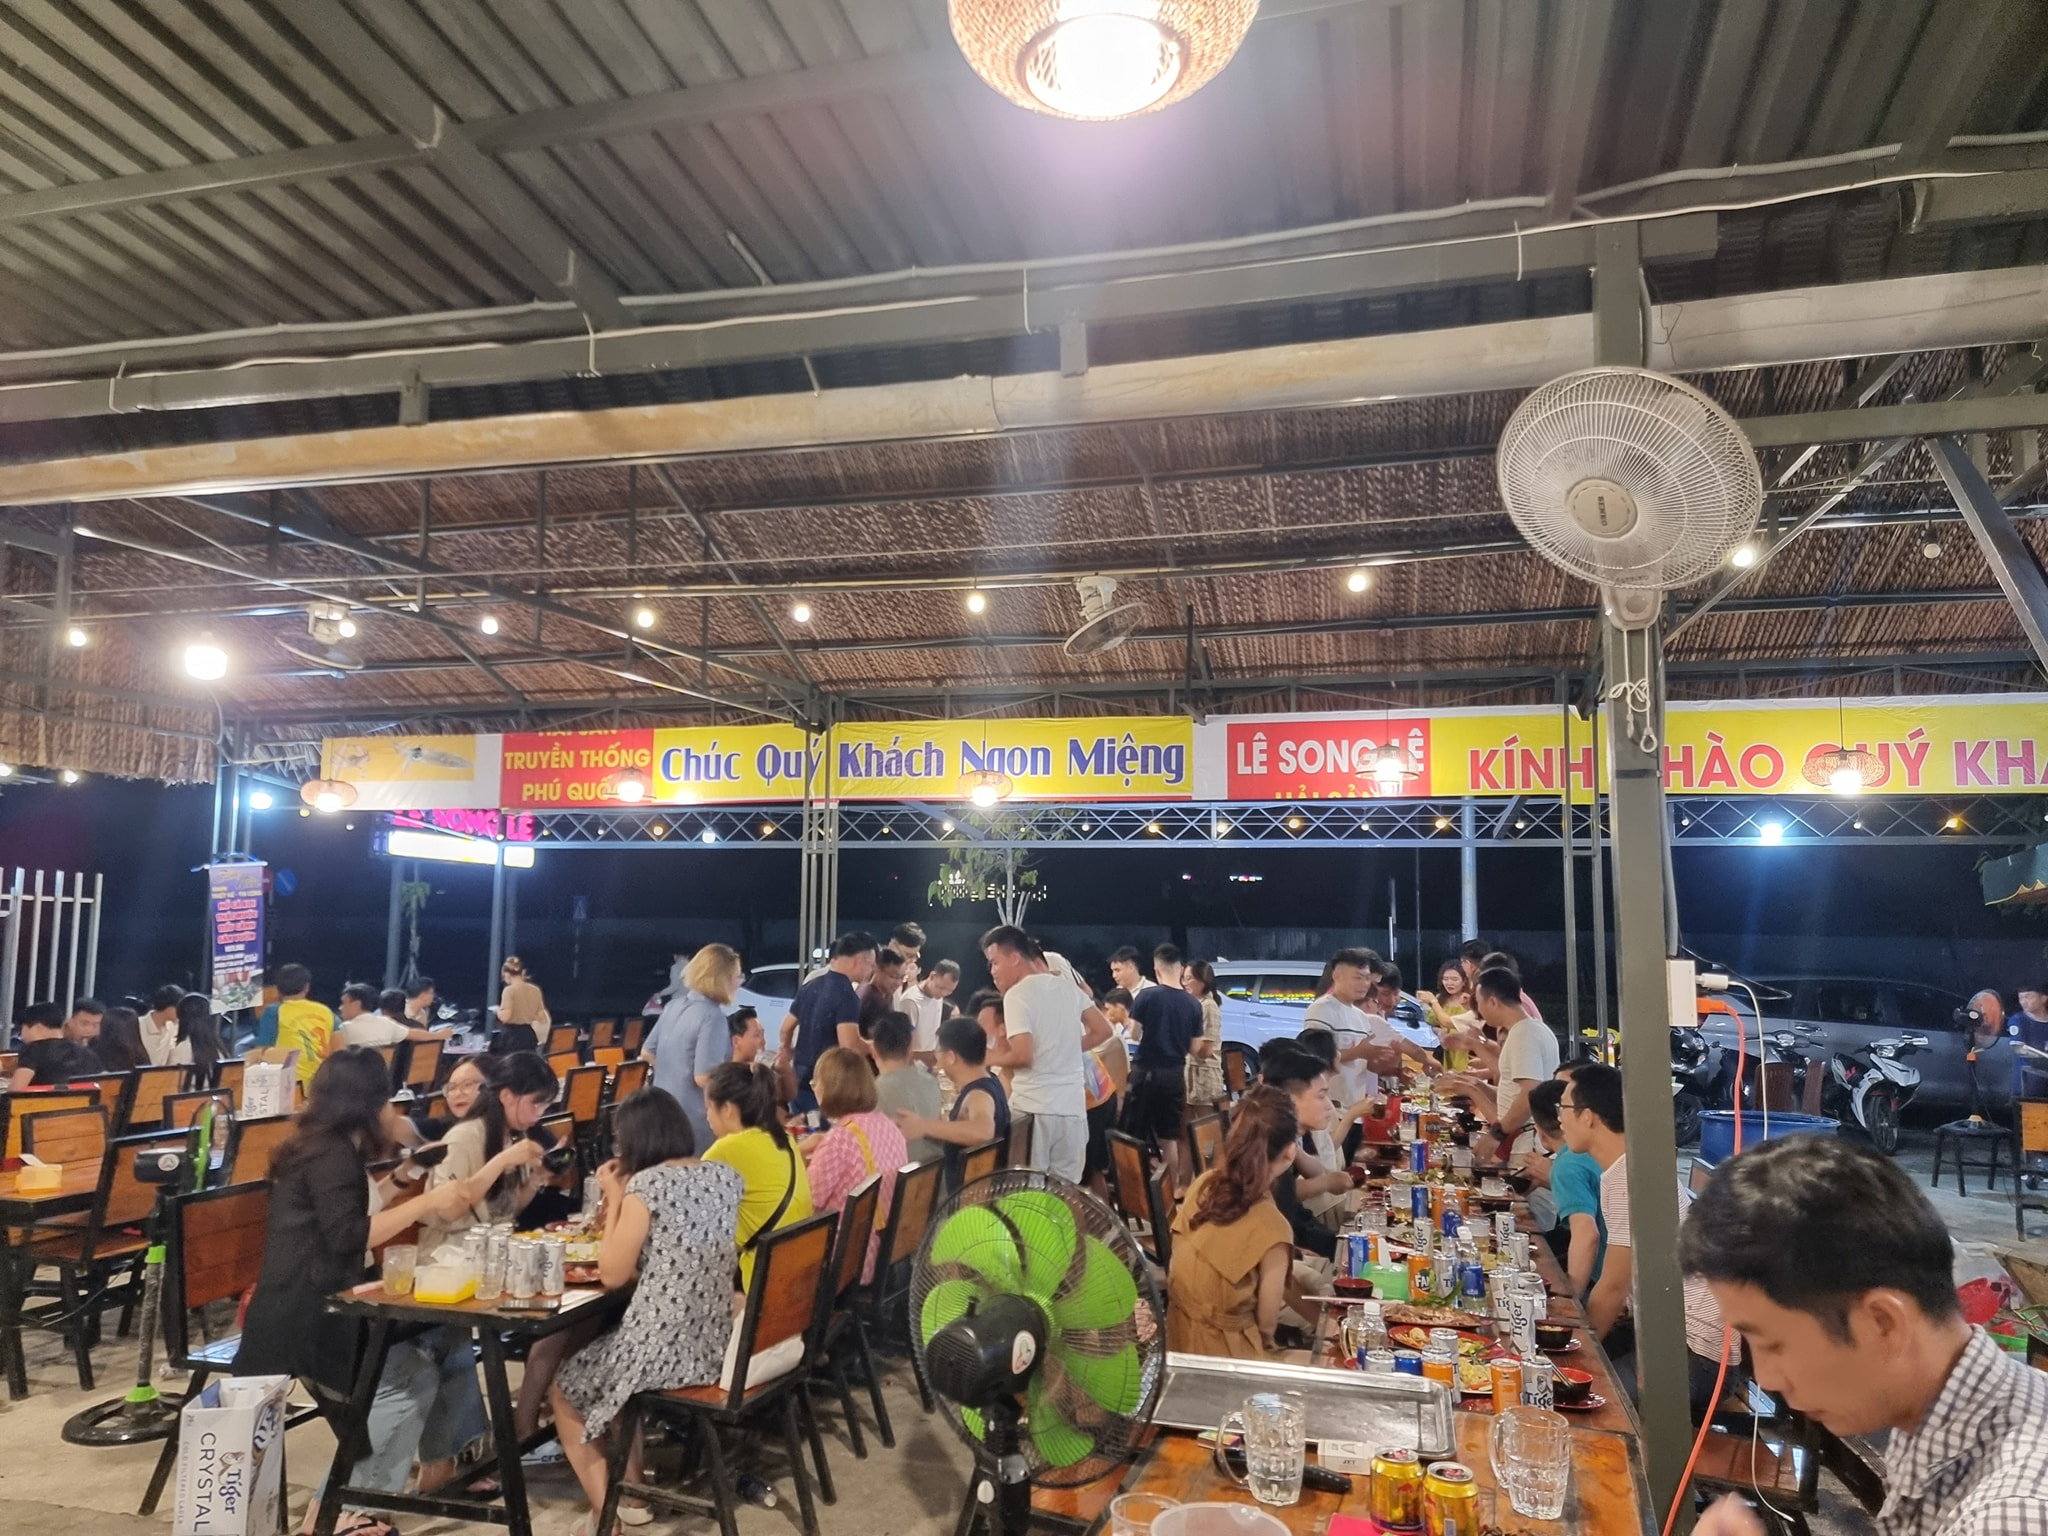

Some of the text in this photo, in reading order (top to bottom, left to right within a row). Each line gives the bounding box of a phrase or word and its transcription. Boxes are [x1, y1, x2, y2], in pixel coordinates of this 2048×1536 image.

[504, 742, 651, 769] TRUYỀN THỐNG
[661, 732, 1185, 787] Chúc Quý Khách Ngon Miệng
[1237, 732, 1268, 775] LÊ
[1279, 739, 1376, 775] SONG
[1470, 735, 1594, 790] KÍNH
[1663, 731, 1785, 789] HÀO
[1954, 739, 2048, 787] KH
[522, 775, 622, 801] PHÚ QUỐ
[1512, 1302, 1528, 1338] Tiger
[1525, 1391, 1554, 1409] Tige
[193, 1432, 217, 1533] CRYSTAL
[218, 1468, 242, 1514] Tiger
